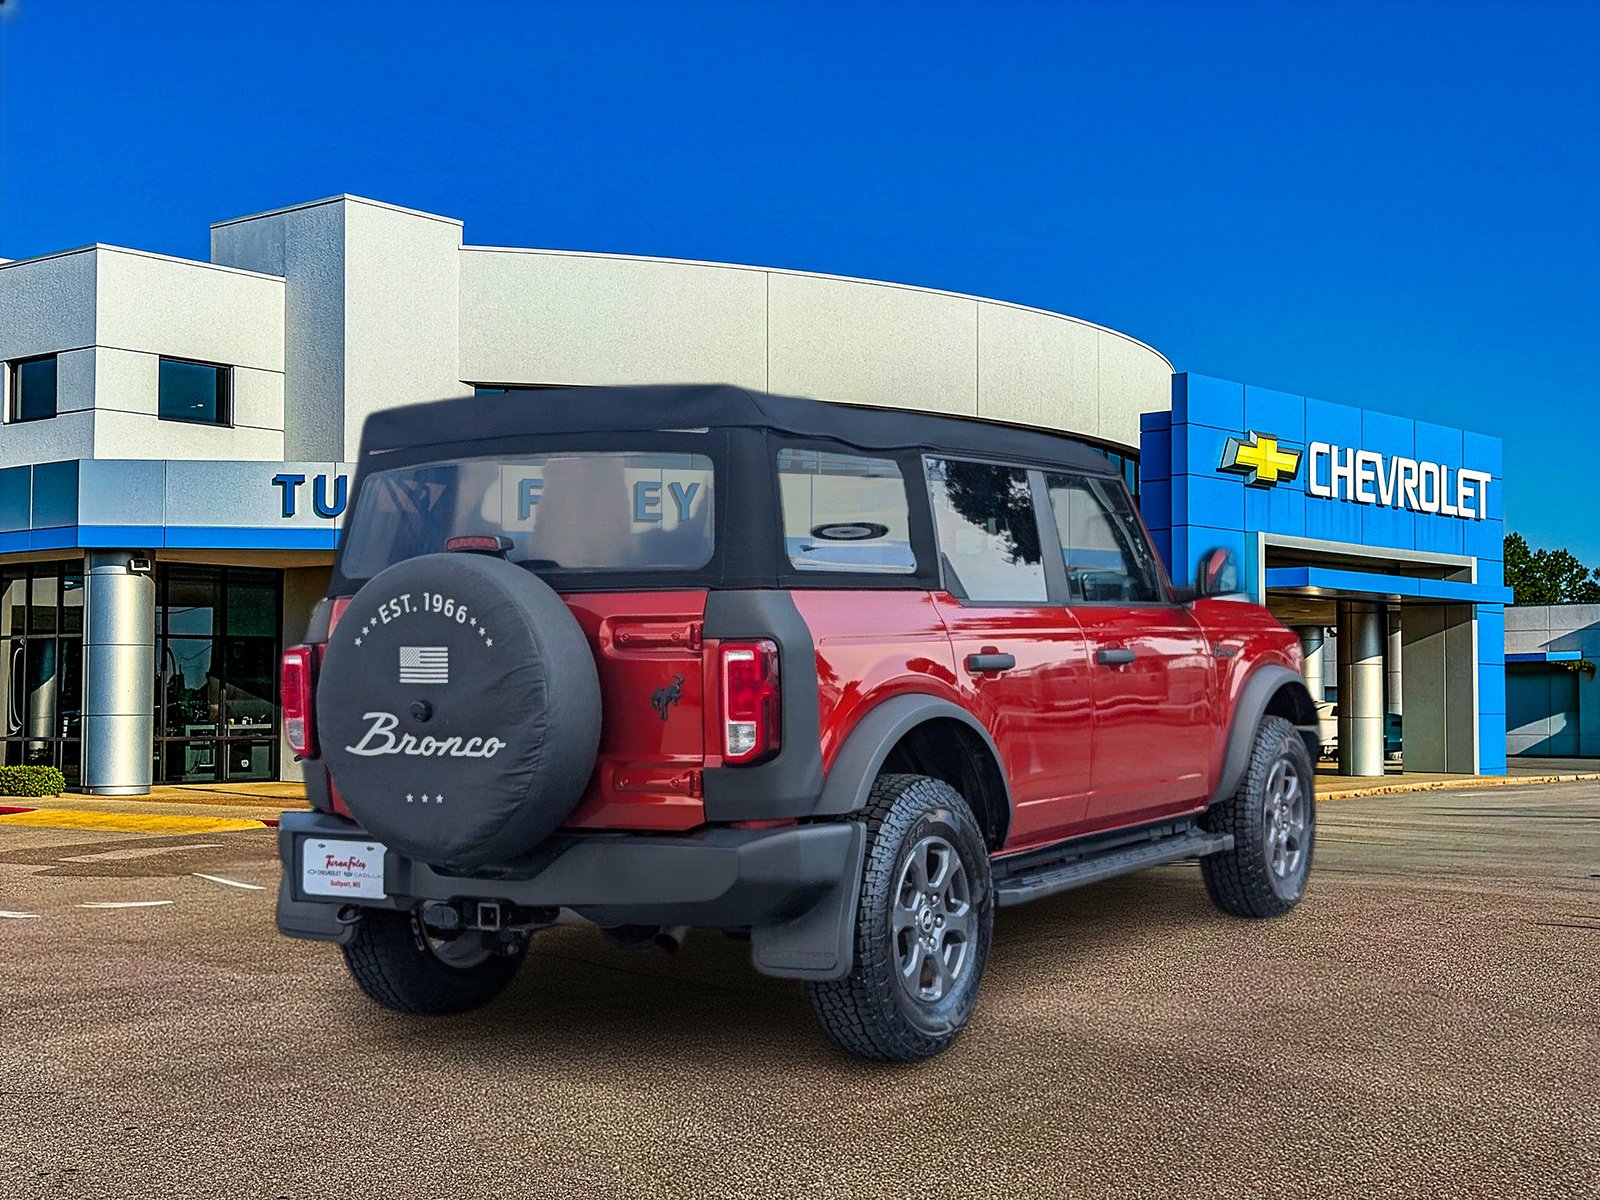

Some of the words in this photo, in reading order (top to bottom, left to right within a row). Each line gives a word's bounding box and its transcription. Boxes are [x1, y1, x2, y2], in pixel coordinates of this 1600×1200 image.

[272, 473, 347, 518] TU
[518, 477, 701, 522] FEY
[1308, 441, 1492, 520] CHEVROLET
[378, 593, 417, 625] EST.
[423, 592, 468, 624] 1966
[345, 711, 507, 758] Bronco
